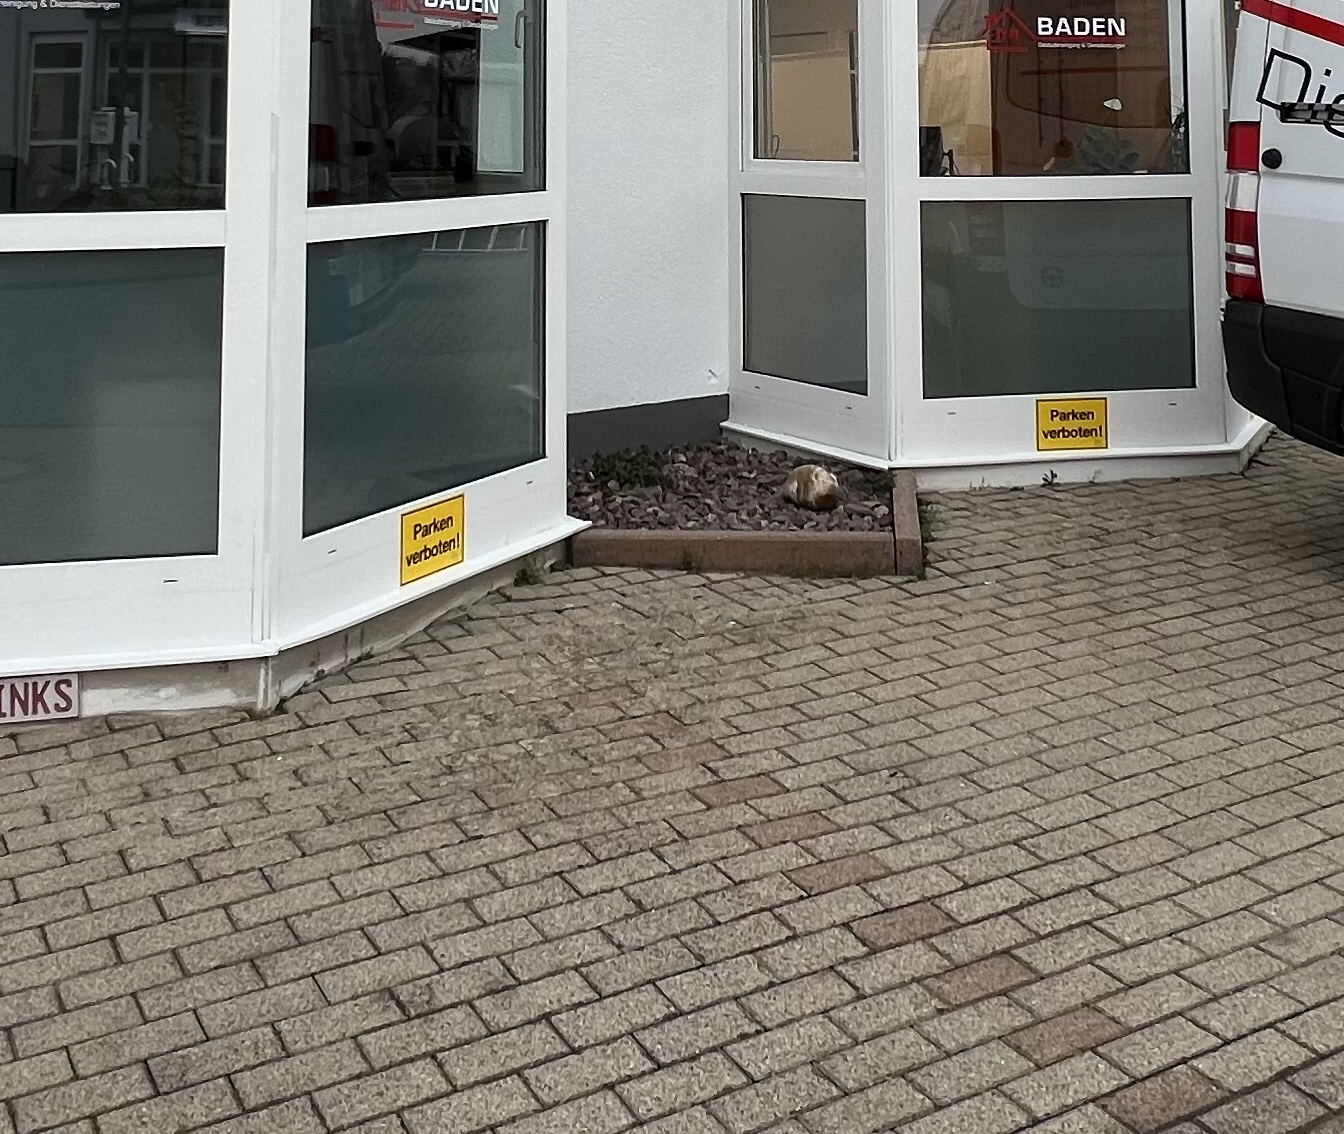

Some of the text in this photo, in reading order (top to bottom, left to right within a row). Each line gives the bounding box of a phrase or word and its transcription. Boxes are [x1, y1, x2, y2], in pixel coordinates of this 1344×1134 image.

[1037, 16, 1126, 36] BADEN
[1050, 409, 1095, 422] Parken
[1042, 425, 1103, 440] verboten!
[413, 515, 454, 541] Parken
[405, 531, 460, 568] verboten!
